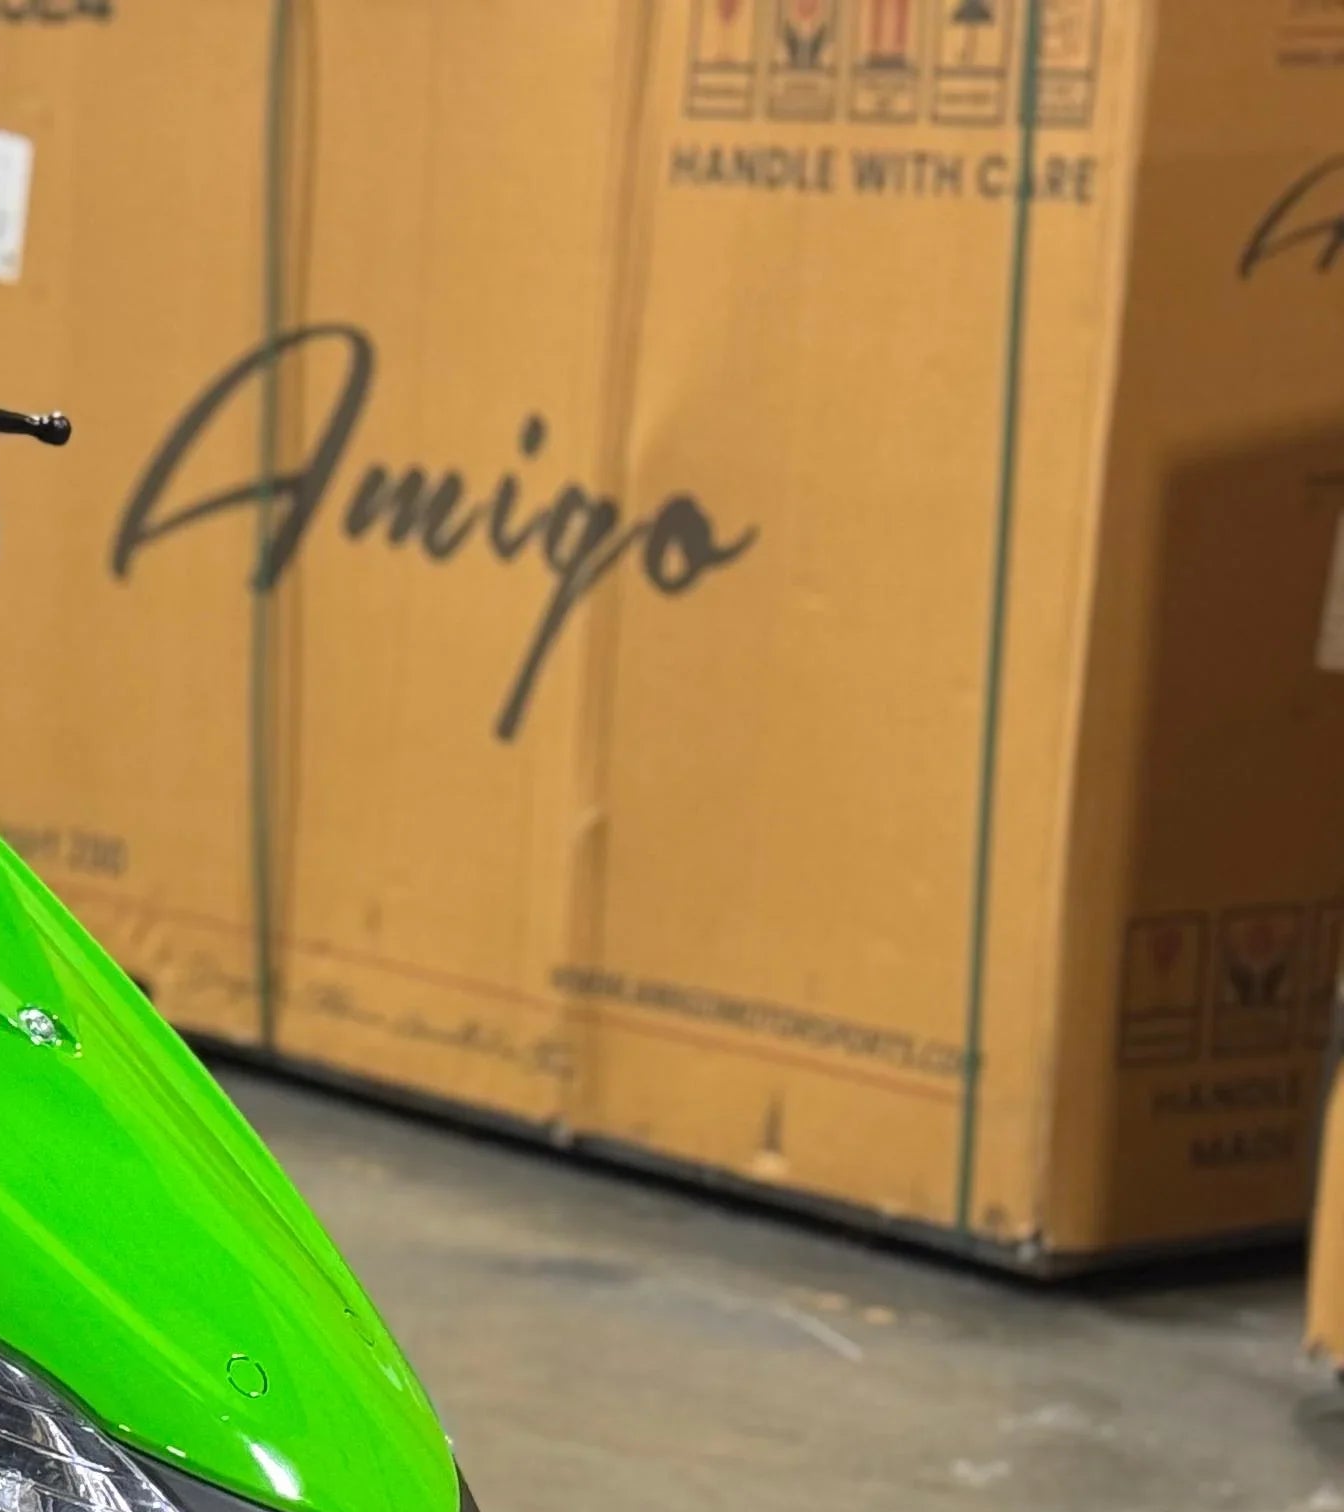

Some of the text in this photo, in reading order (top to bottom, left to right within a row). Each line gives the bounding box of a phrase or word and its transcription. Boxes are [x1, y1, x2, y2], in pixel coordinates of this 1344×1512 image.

[669, 143, 836, 193] HANDLE
[851, 147, 964, 196] WITH
[109, 322, 760, 744] Amigo
